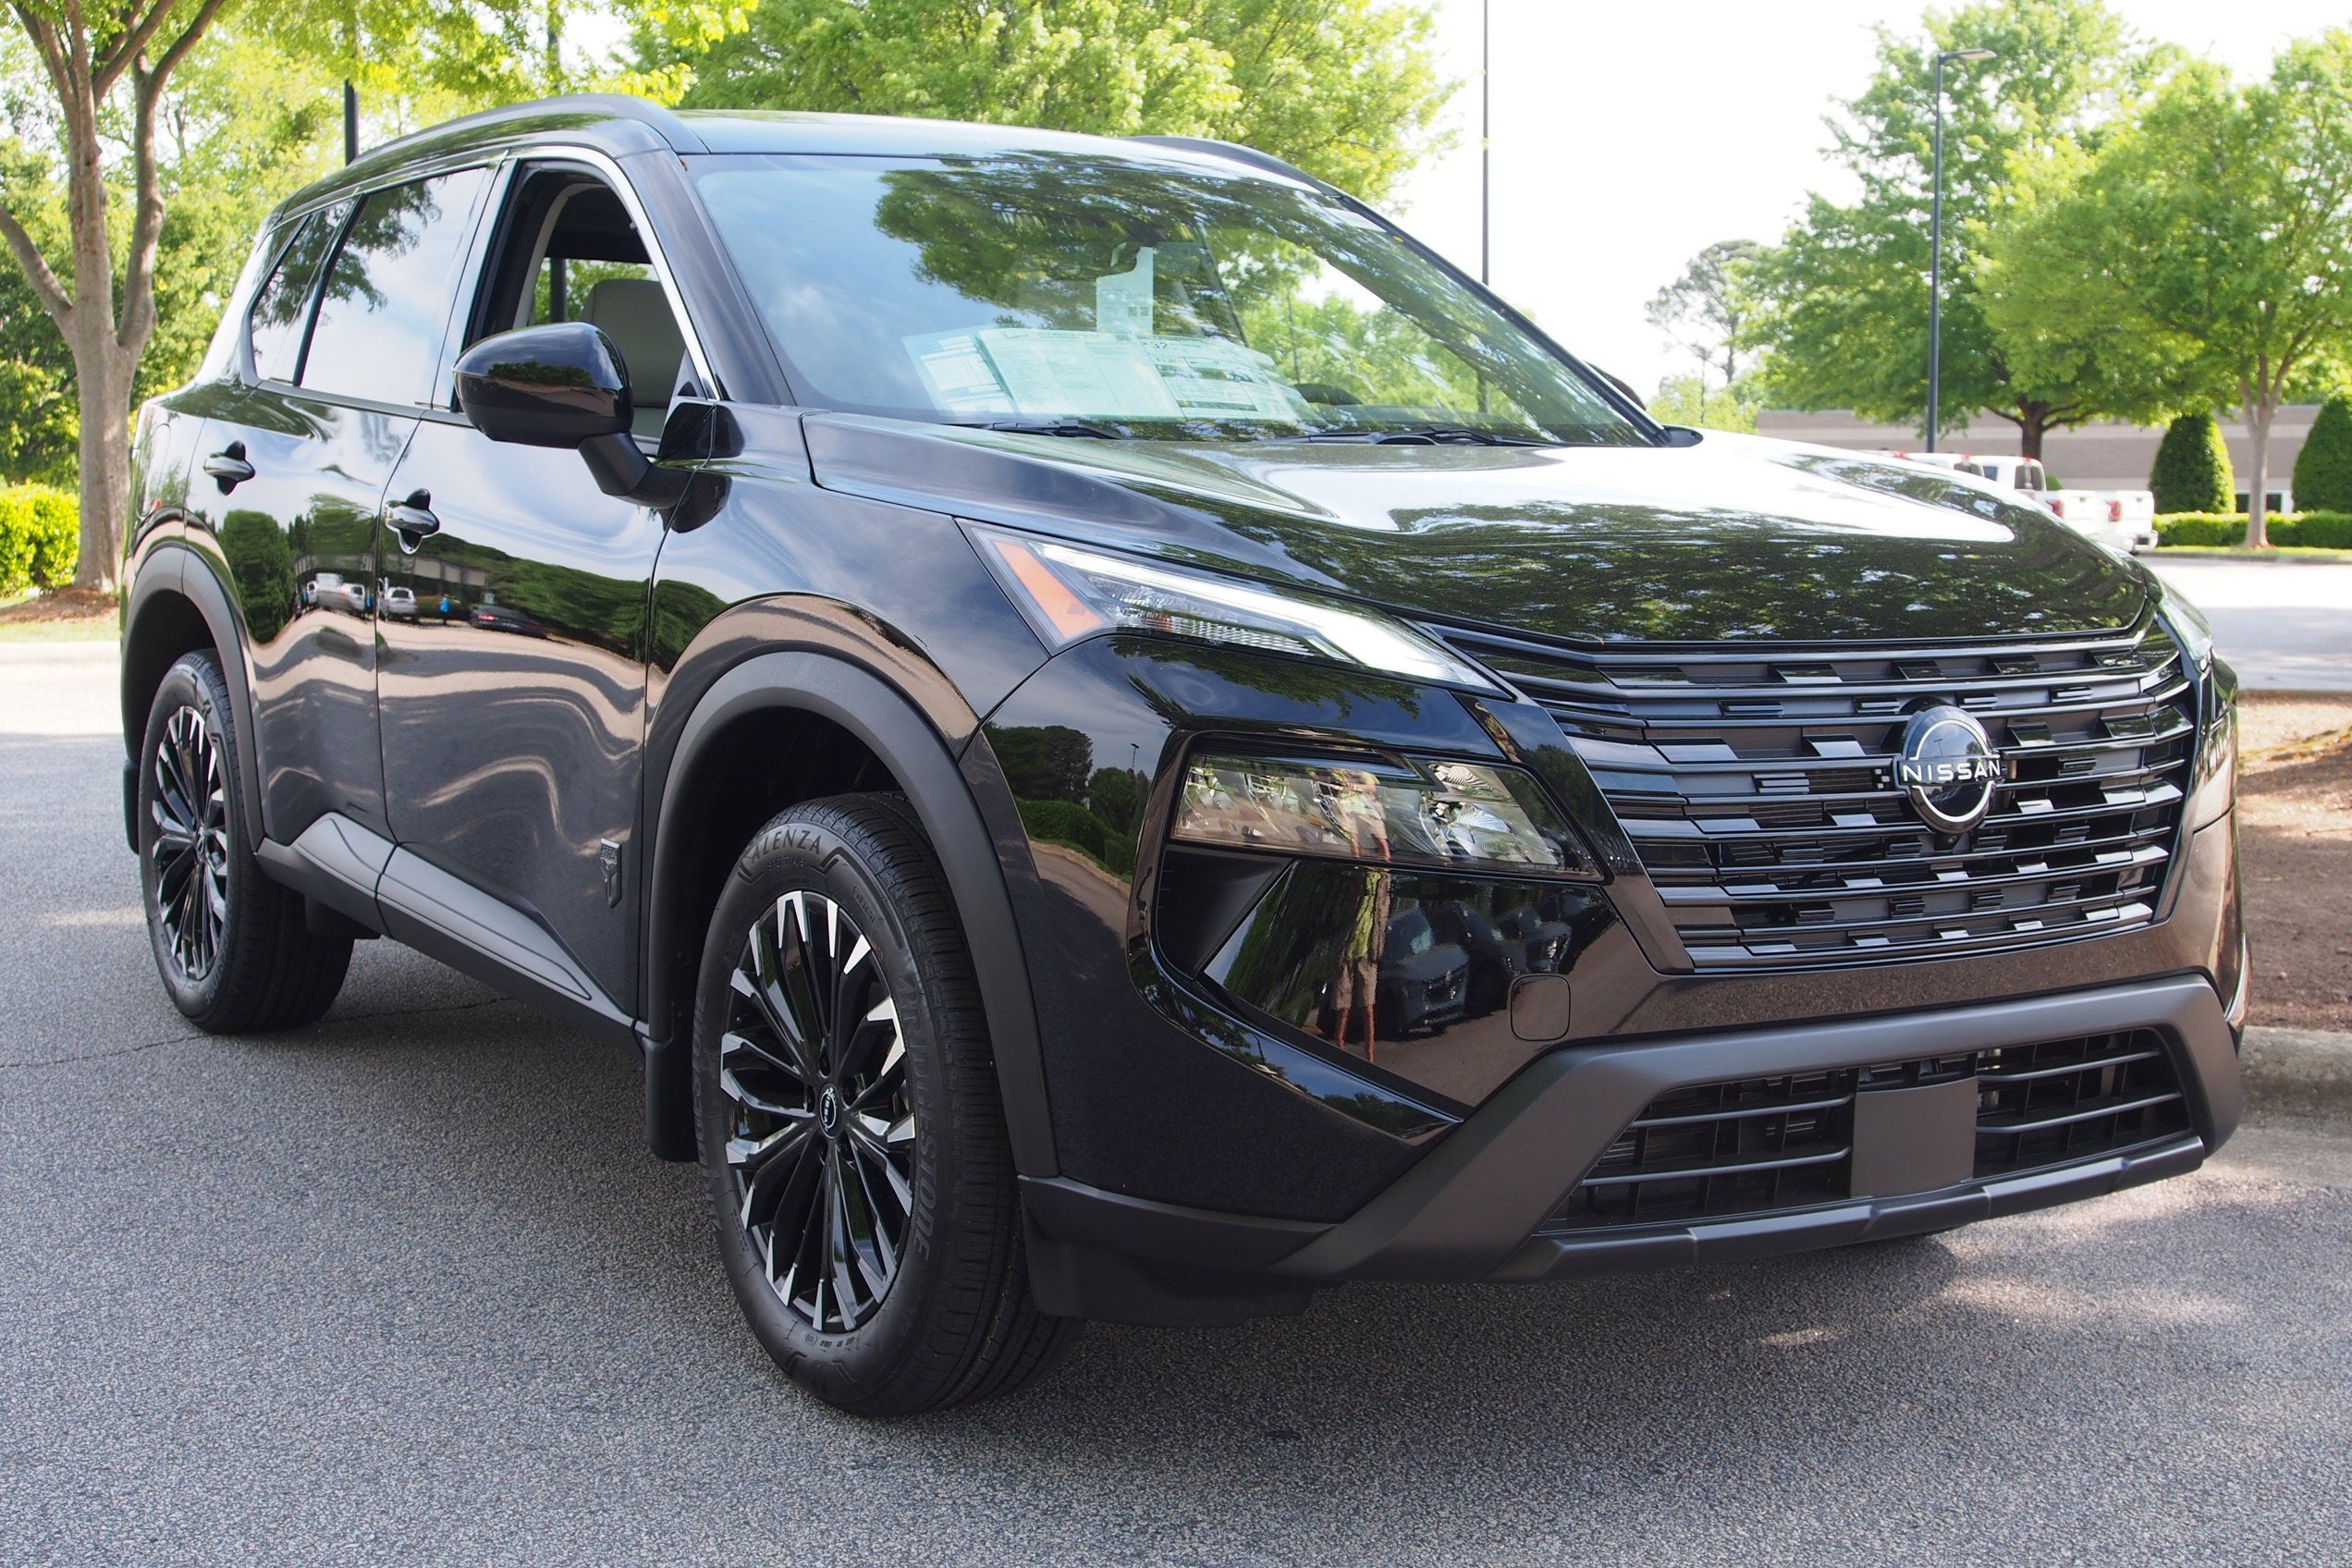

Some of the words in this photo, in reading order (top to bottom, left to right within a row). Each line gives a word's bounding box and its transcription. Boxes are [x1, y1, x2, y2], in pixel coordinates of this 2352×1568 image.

[1903, 760, 2000, 782] NISSAN
[751, 830, 821, 862] ALENZA
[898, 973, 937, 1262] BRIDGESTONE
